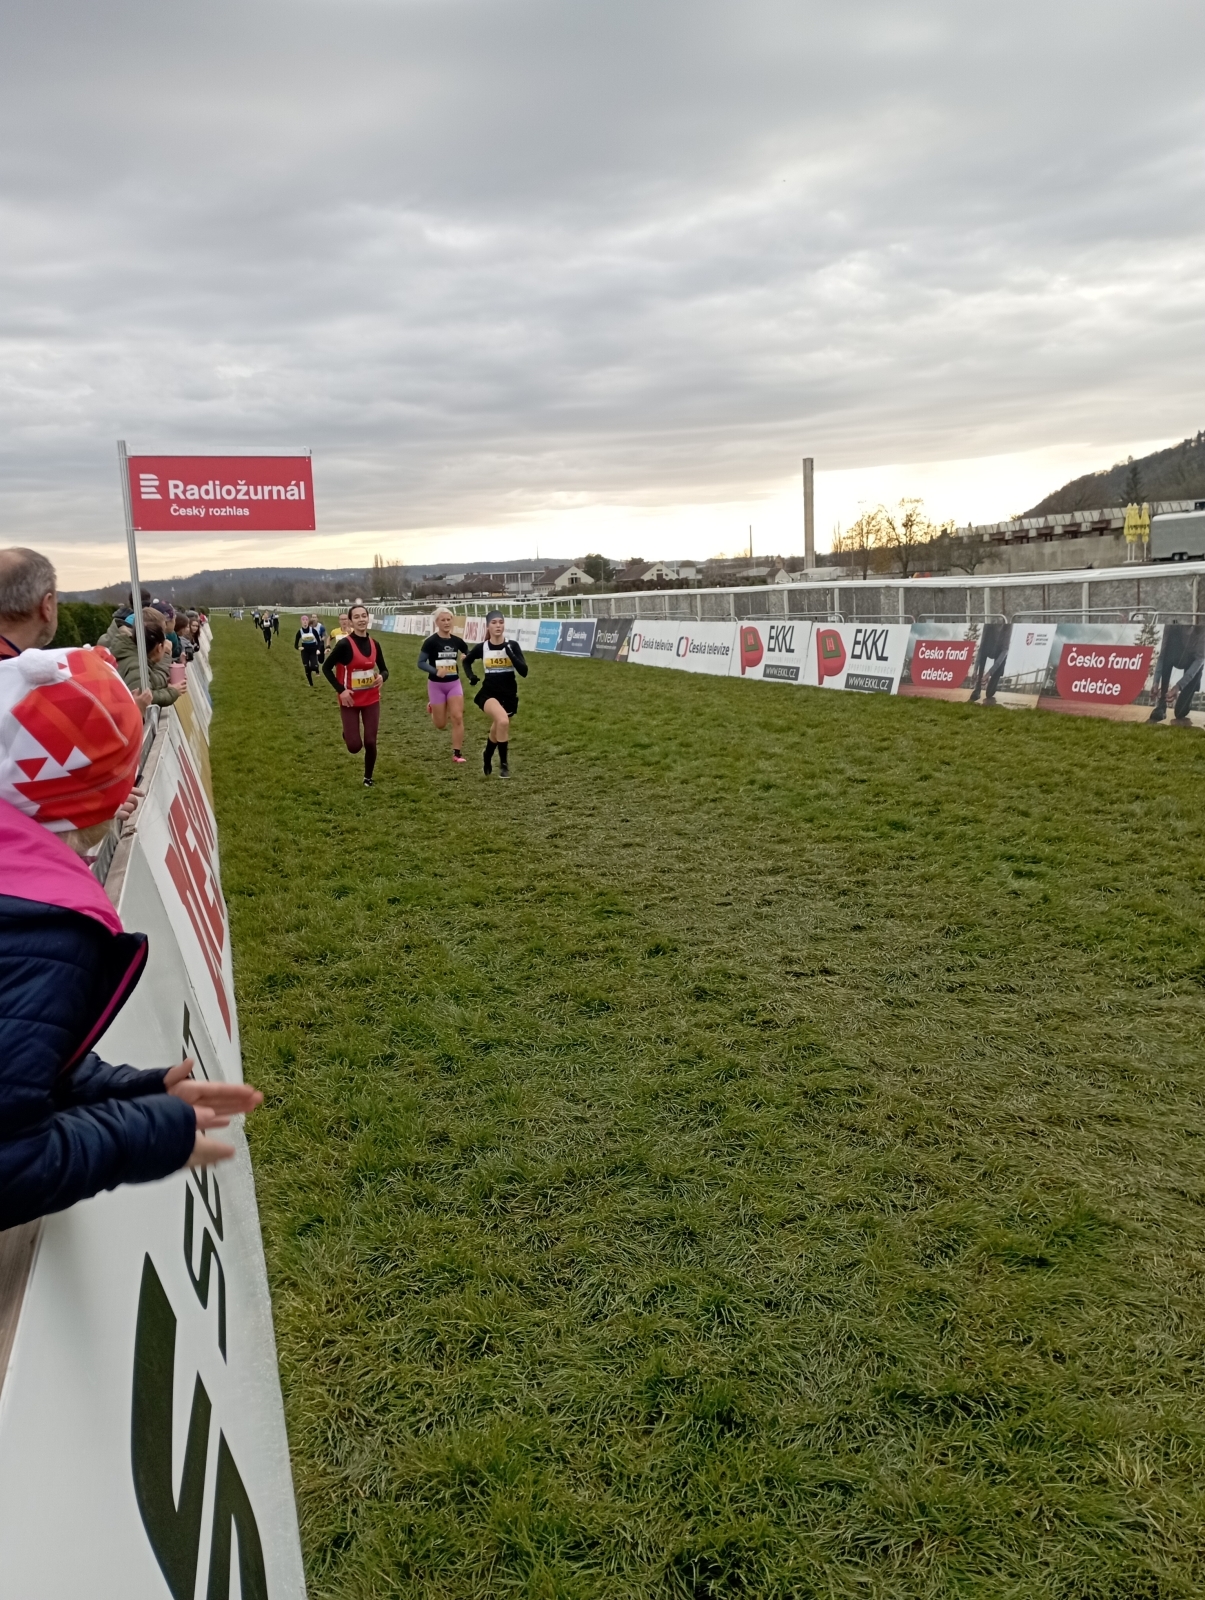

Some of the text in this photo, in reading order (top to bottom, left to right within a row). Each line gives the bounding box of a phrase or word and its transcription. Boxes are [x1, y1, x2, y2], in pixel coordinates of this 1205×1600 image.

[168, 479, 306, 500] Radiožurnál
[170, 504, 250, 517] Český rozhlas
[641, 636, 673, 652] Česká televize
[688, 639, 730, 656] Česká televize
[767, 626, 795, 653] EKKL
[851, 629, 889, 661] EKKL
[918, 643, 968, 661] Česko fandí
[1068, 647, 1143, 671] Česko fandí
[765, 667, 796, 678] WWW.EKKL.CZ
[921, 667, 953, 682] atletice
[848, 677, 889, 690] WWW.EKKL.CZ
[1072, 679, 1121, 696] atletice
[182, 1000, 228, 1365] SET
